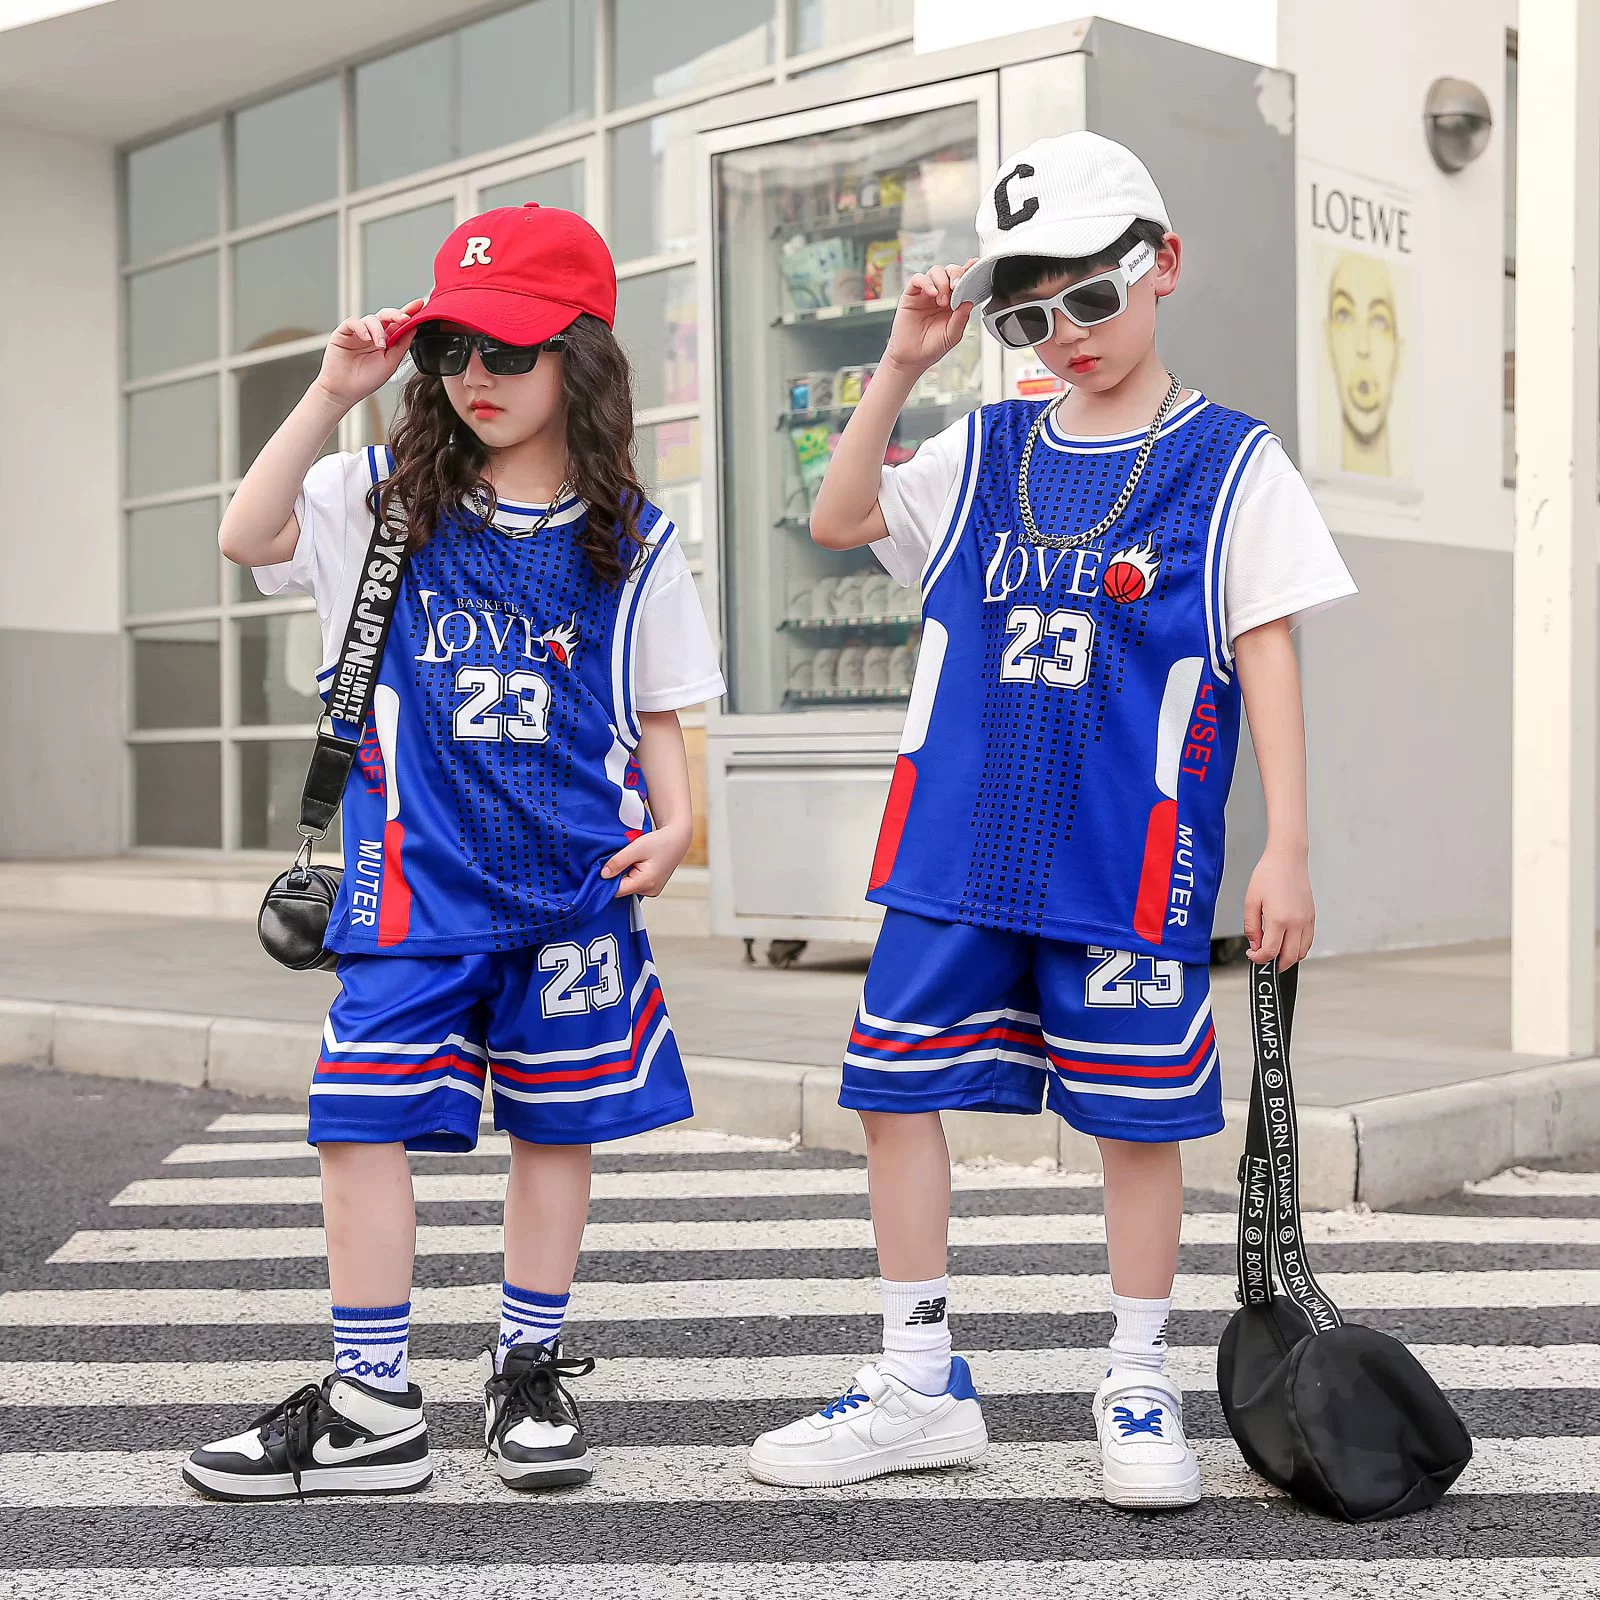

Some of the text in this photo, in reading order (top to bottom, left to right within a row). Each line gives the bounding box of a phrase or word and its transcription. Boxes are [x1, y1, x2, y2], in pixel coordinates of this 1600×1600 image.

[994, 163, 1039, 231] C
[1309, 182, 1414, 255] LOEWE
[459, 236, 492, 268] R
[983, 530, 1103, 603] LOVE
[414, 590, 549, 663] LOVE
[1000, 605, 1097, 690] 23
[453, 665, 552, 744] 23
[1182, 683, 1218, 781] LUSET
[351, 838, 384, 927] MUTER
[1168, 823, 1194, 927] MUTER
[538, 932, 625, 1019] 23
[1084, 944, 1184, 1009] 23
[1258, 981, 1279, 1060] CHAMPS
[1269, 1096, 1290, 1149] BORN
[1276, 1154, 1293, 1220] CHAMPS
[1246, 1251, 1263, 1287] BORN
[1284, 1250, 1313, 1299] BORN
[336, 1348, 404, 1379] Cool
